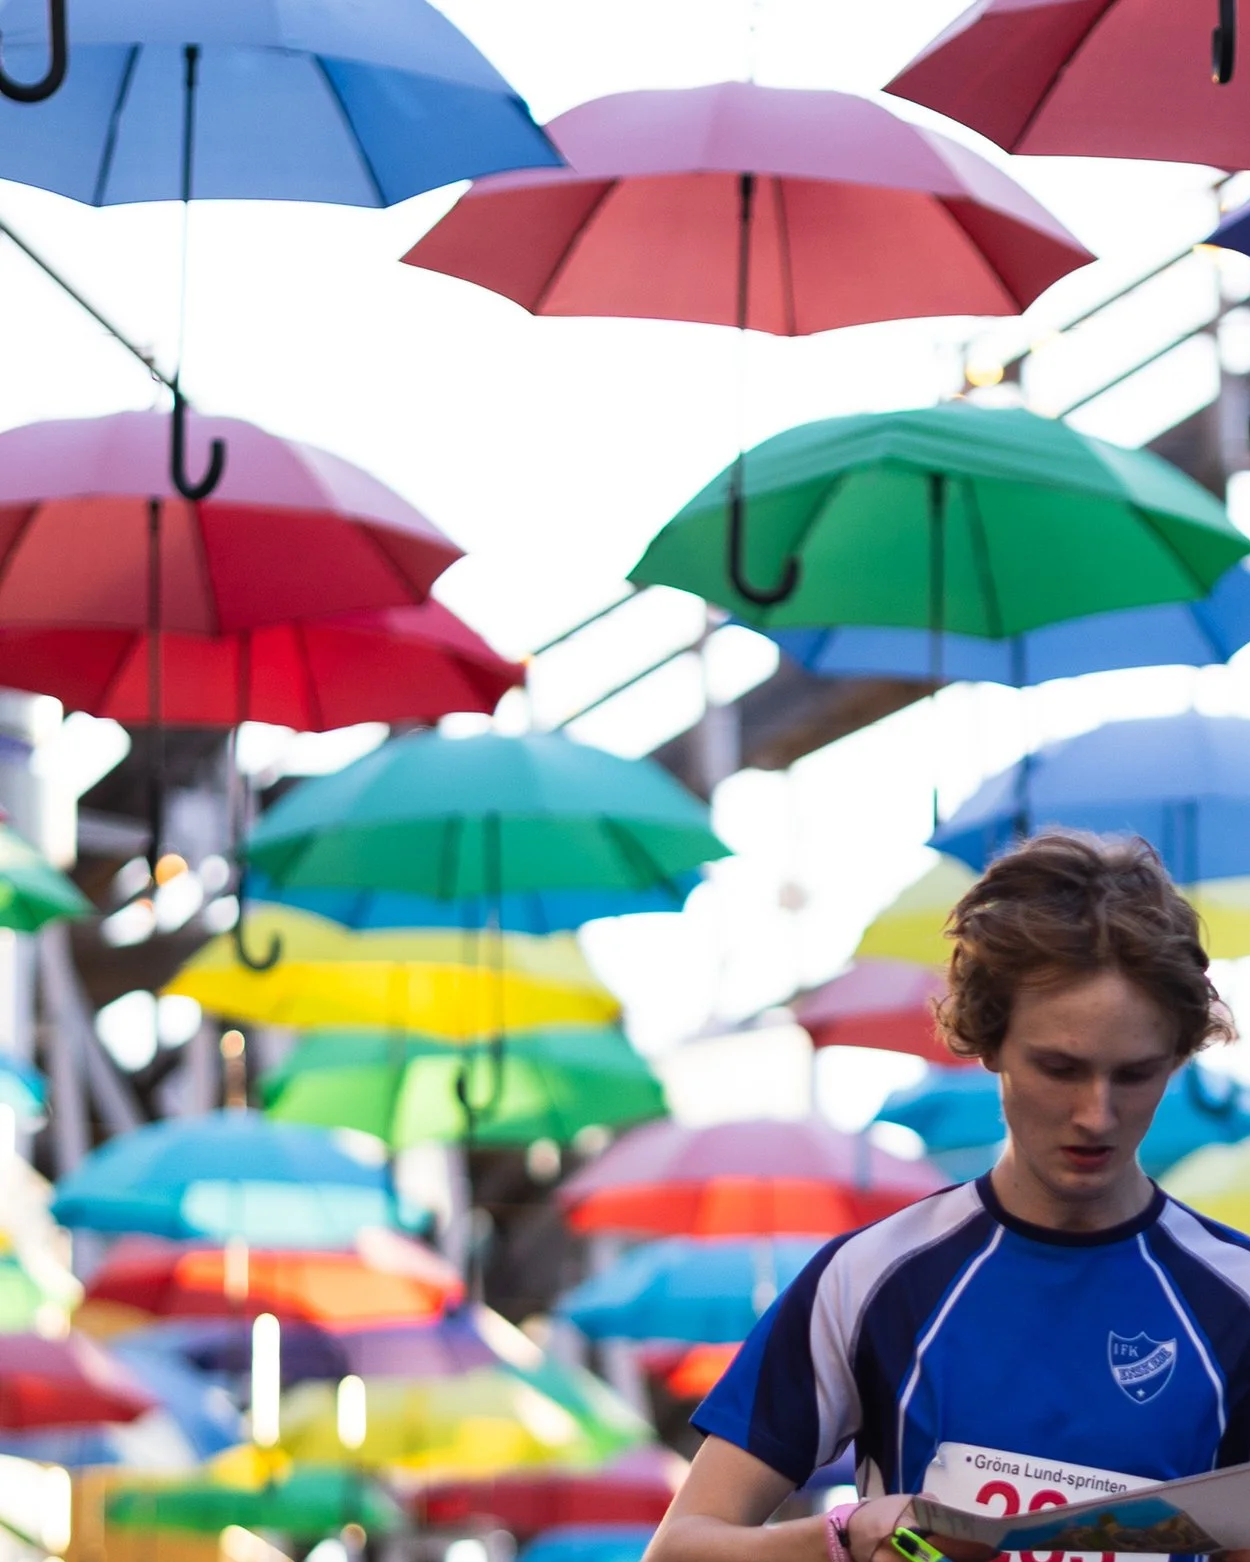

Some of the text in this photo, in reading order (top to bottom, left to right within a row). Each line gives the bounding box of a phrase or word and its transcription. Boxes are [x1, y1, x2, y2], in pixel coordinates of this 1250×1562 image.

[1113, 1343, 1139, 1357] IFK
[974, 1454, 1128, 1494] Gröna Lund-sprinten
